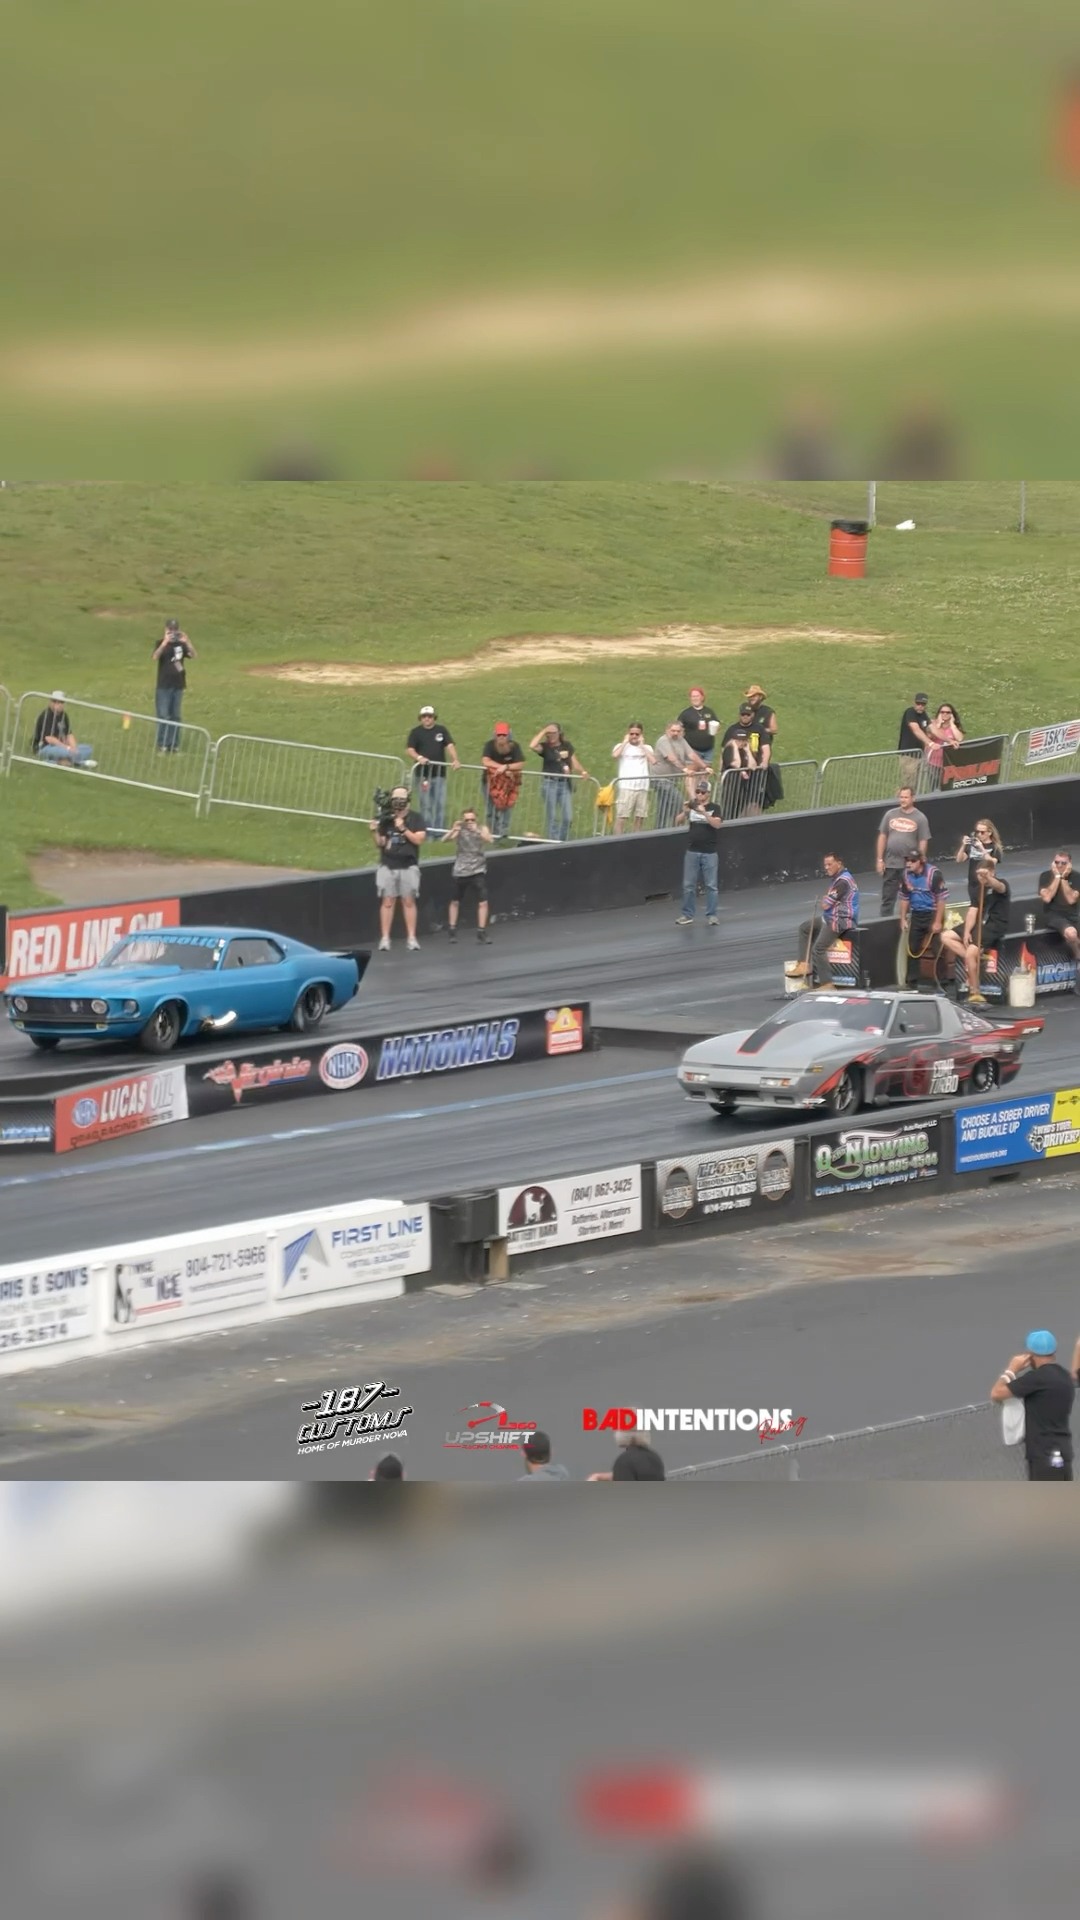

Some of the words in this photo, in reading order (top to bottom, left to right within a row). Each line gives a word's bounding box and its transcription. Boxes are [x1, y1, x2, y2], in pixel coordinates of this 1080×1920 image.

[1043, 726, 1069, 748] ISKY
[1028, 746, 1055, 758] RACING
[952, 776, 988, 788] RACING
[8, 924, 61, 978] RED
[65, 916, 124, 971] LINE
[376, 1018, 520, 1081] NATIONALS
[326, 1052, 362, 1080] NHRA
[100, 1081, 148, 1123] LUCAS
[151, 1073, 175, 1111] OIL
[928, 1075, 959, 1095] TURBO
[101, 1121, 138, 1136] RACING
[961, 1113, 991, 1129] CHOOSE
[991, 1112, 998, 1123] A
[998, 1108, 1023, 1123] SOBER
[1023, 1103, 1050, 1119] DRIVER
[961, 1129, 977, 1142] AND
[978, 1123, 1009, 1139] BUCKLE
[1009, 1121, 1020, 1134] UP
[815, 1184, 844, 1196] Official
[846, 1179, 872, 1192] Towing
[873, 1173, 908, 1187] Company
[909, 1170, 918, 1180] of
[331, 1223, 382, 1248] FIRST
[388, 1216, 423, 1238] LINE
[46, 1266, 88, 1292] SON'S
[157, 1272, 182, 1299] ICE
